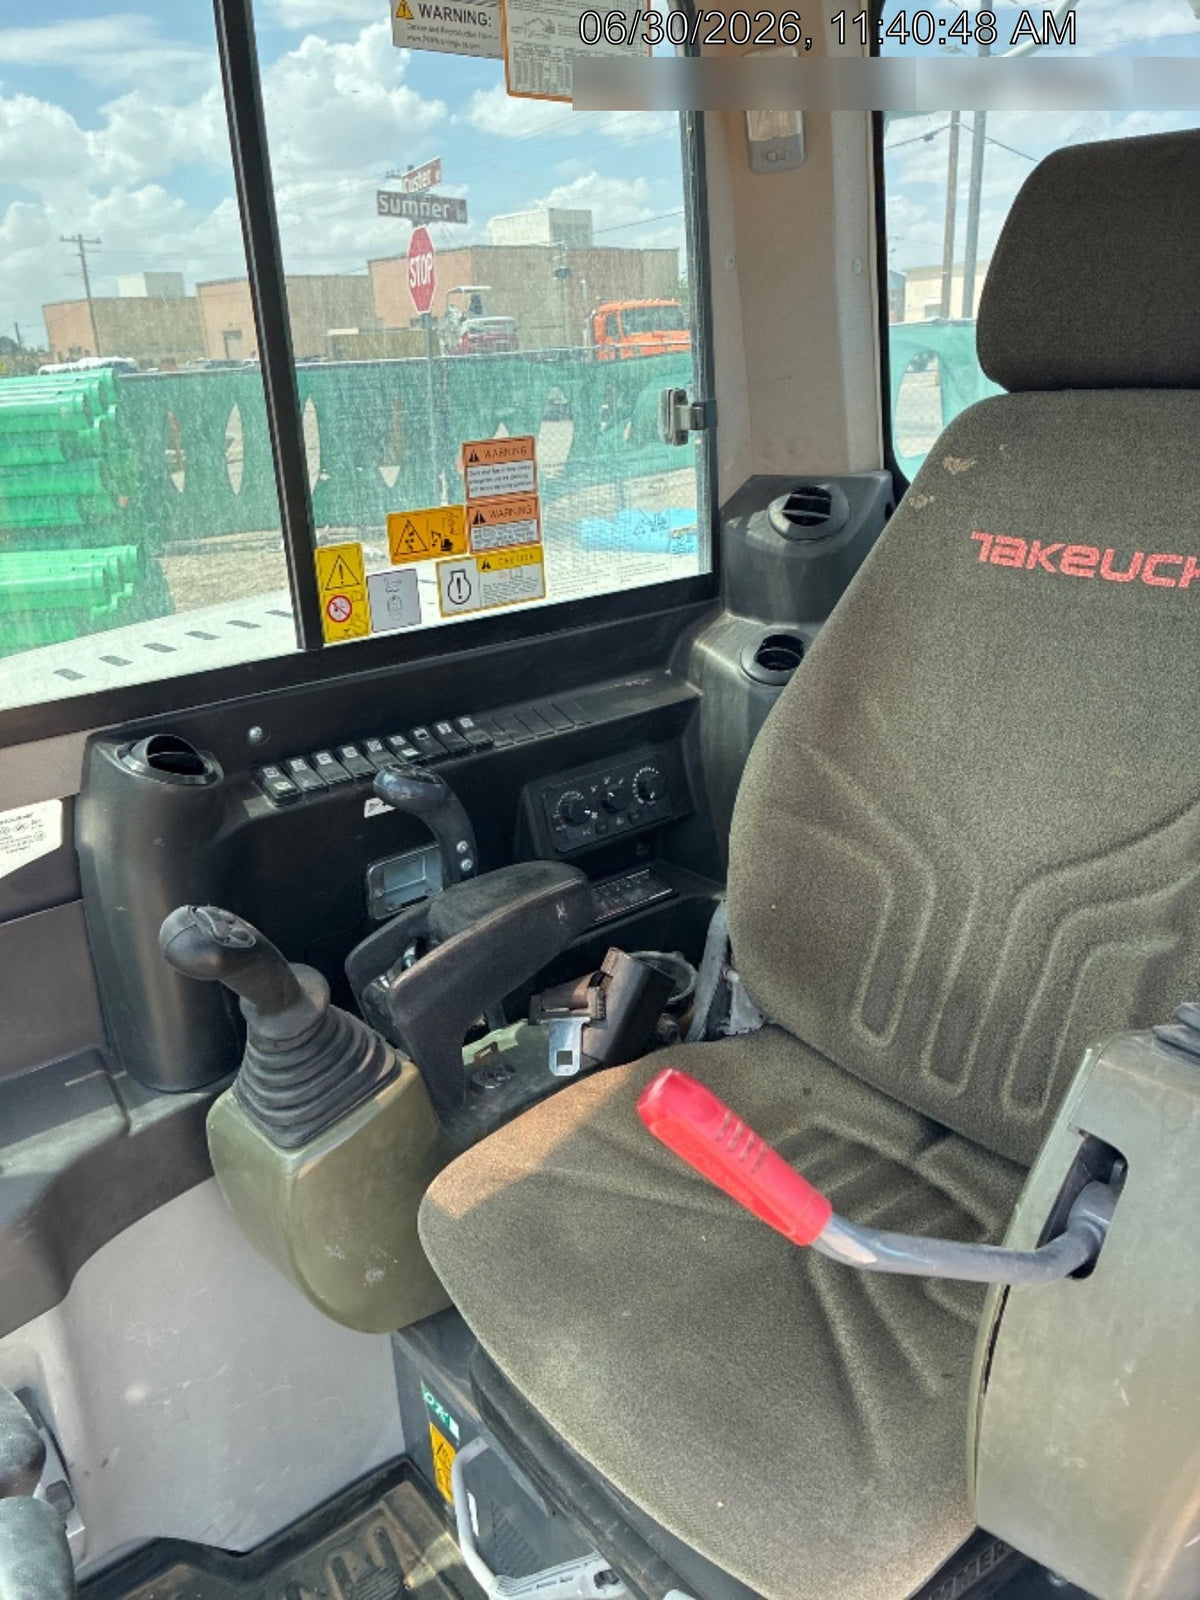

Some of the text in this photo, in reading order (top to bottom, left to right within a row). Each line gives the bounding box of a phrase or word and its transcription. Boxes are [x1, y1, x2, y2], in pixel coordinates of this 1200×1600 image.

[418, 3, 492, 27] WARNING:
[379, 194, 451, 219] Sumner
[409, 252, 433, 289] STOP
